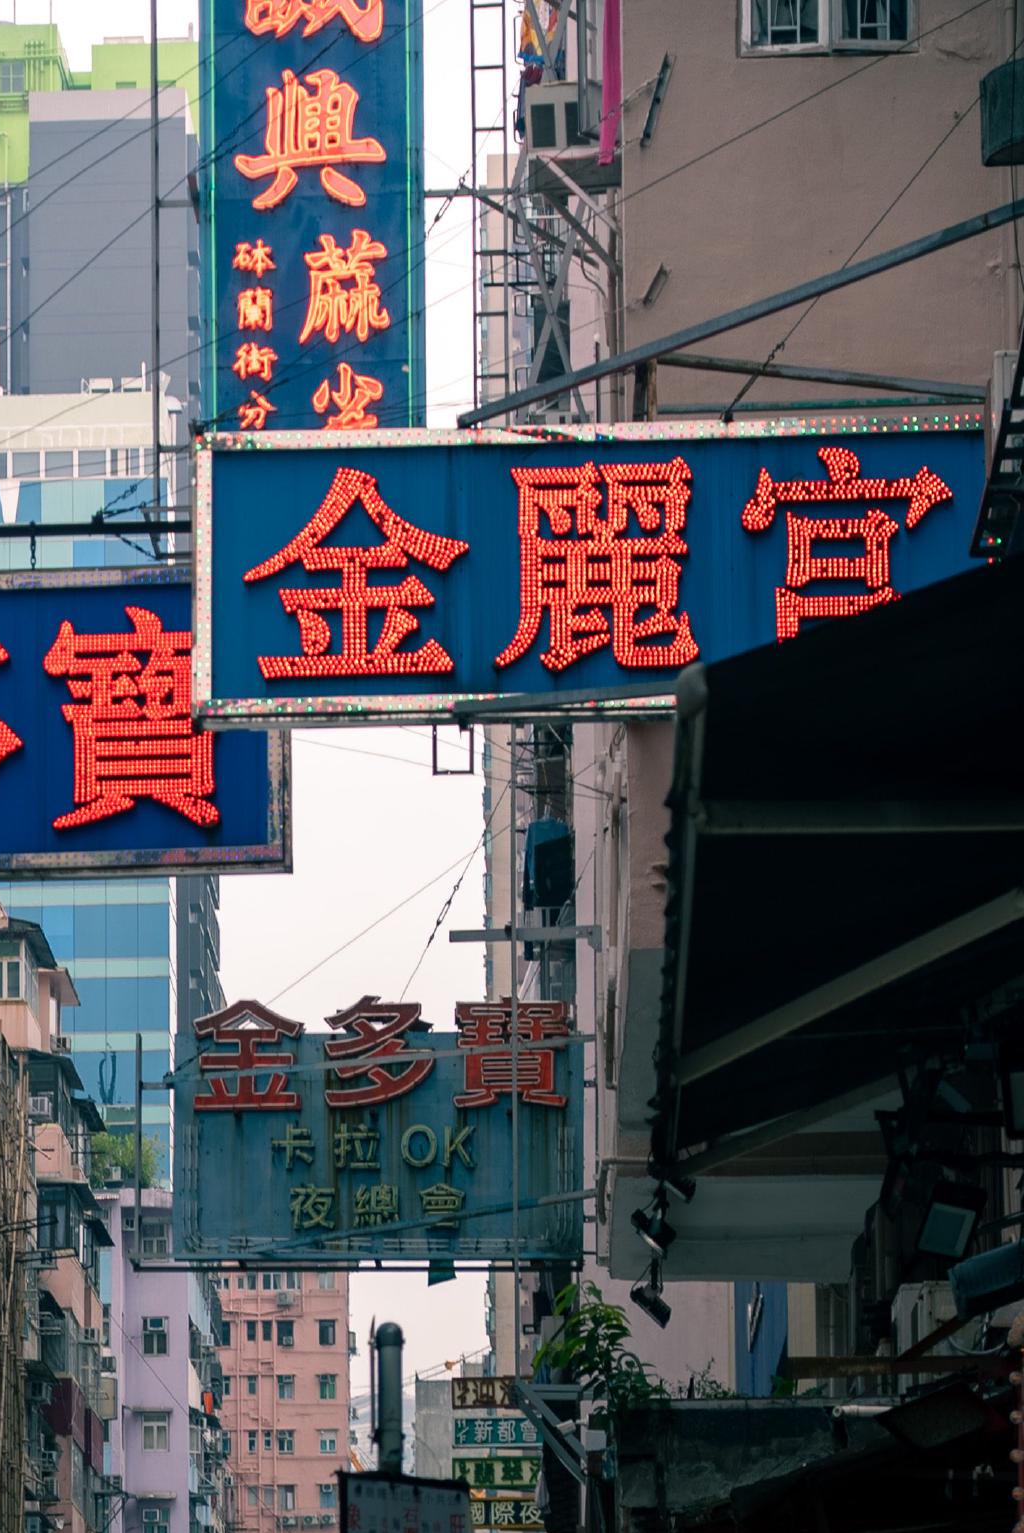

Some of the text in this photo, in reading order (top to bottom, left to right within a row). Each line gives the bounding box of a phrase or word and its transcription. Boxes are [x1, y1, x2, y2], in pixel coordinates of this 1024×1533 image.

[243, 445, 954, 680] 金麗宮
[193, 994, 569, 1112] 金多寶
[289, 1183, 466, 1230] 夜總會
[474, 1418, 538, 1444] 新都會
